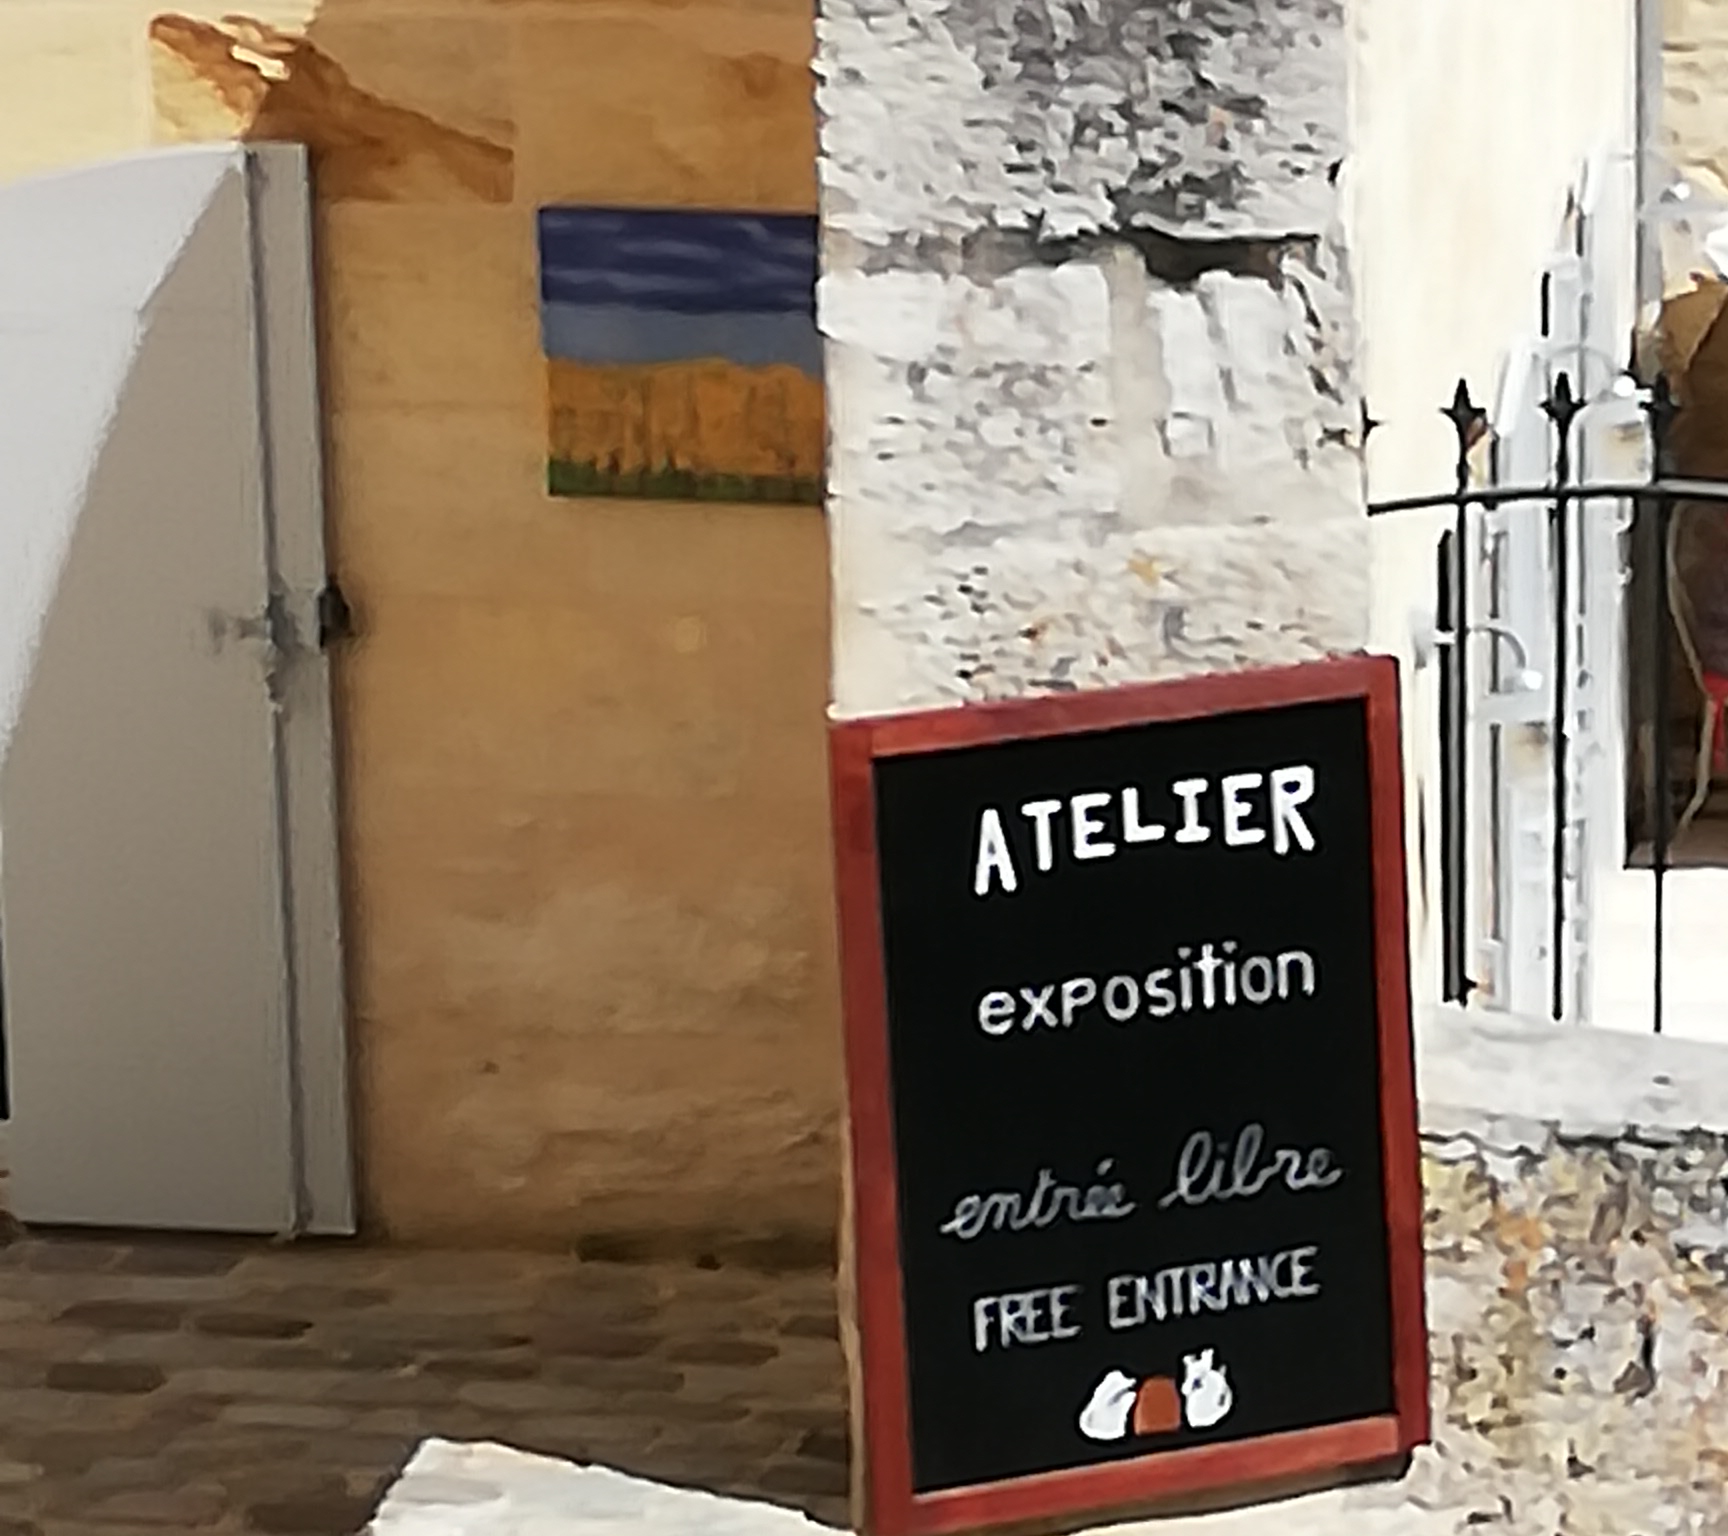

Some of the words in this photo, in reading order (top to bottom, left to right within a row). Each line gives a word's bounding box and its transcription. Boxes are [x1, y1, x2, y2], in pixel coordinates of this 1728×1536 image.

[974, 764, 1316, 896] ATELIER
[978, 940, 1315, 1035] exposition
[940, 1158, 1136, 1239] entrée
[1159, 1124, 1343, 1208] libre
[973, 1285, 1081, 1352] FREE
[1108, 1245, 1320, 1329] ENTRANCE
